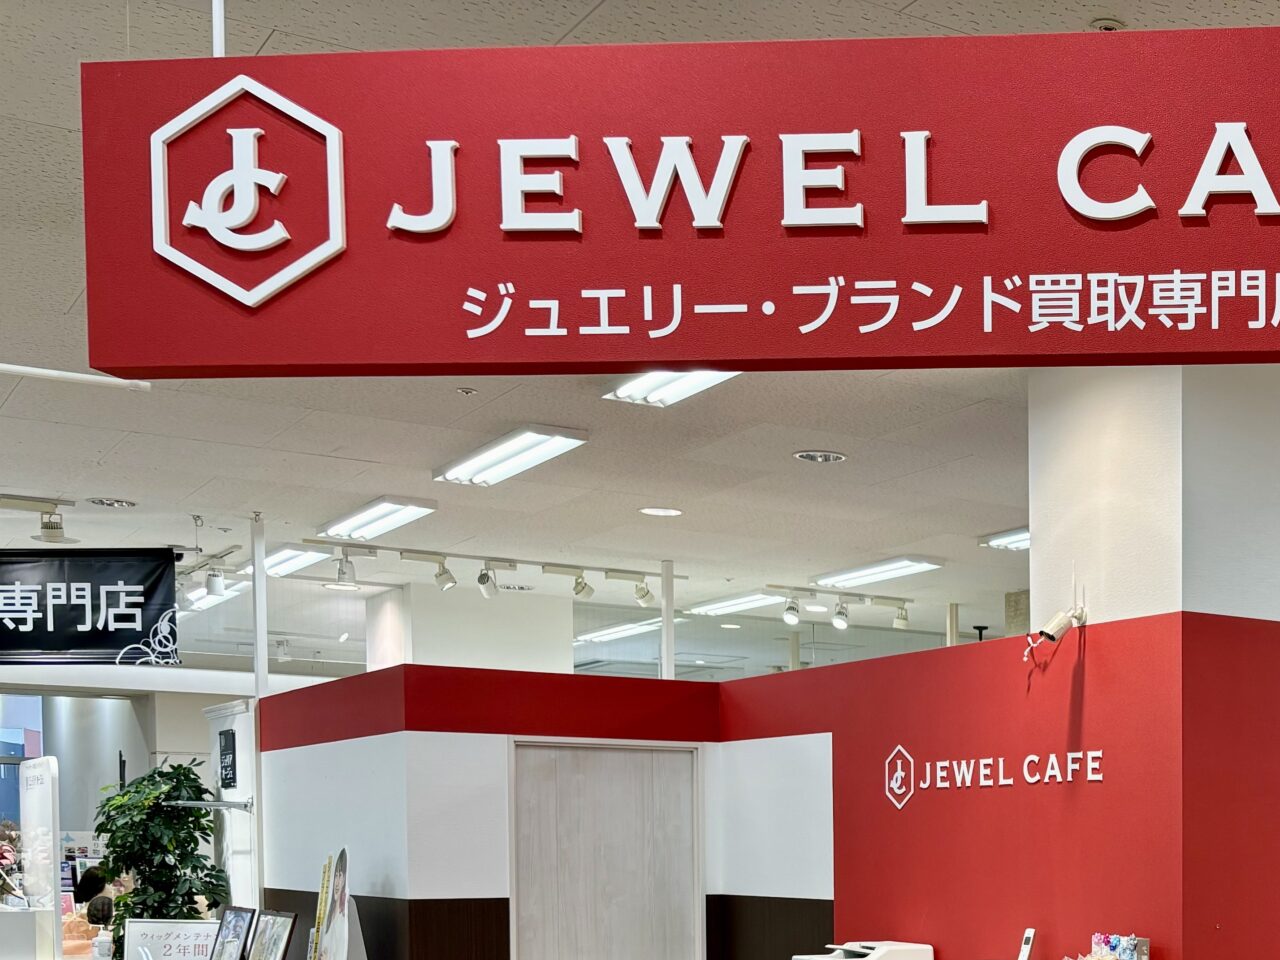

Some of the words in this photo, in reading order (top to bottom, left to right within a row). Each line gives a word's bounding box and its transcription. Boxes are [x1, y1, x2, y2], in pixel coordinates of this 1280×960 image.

[386, 129, 988, 233] JEWEL
[0, 580, 146, 632] 専門店
[919, 757, 1014, 789] JEWEL
[1022, 750, 1104, 784] CAFE
[140, 931, 219, 941] ウィッグメンテナ
[162, 943, 209, 958] 2年間
